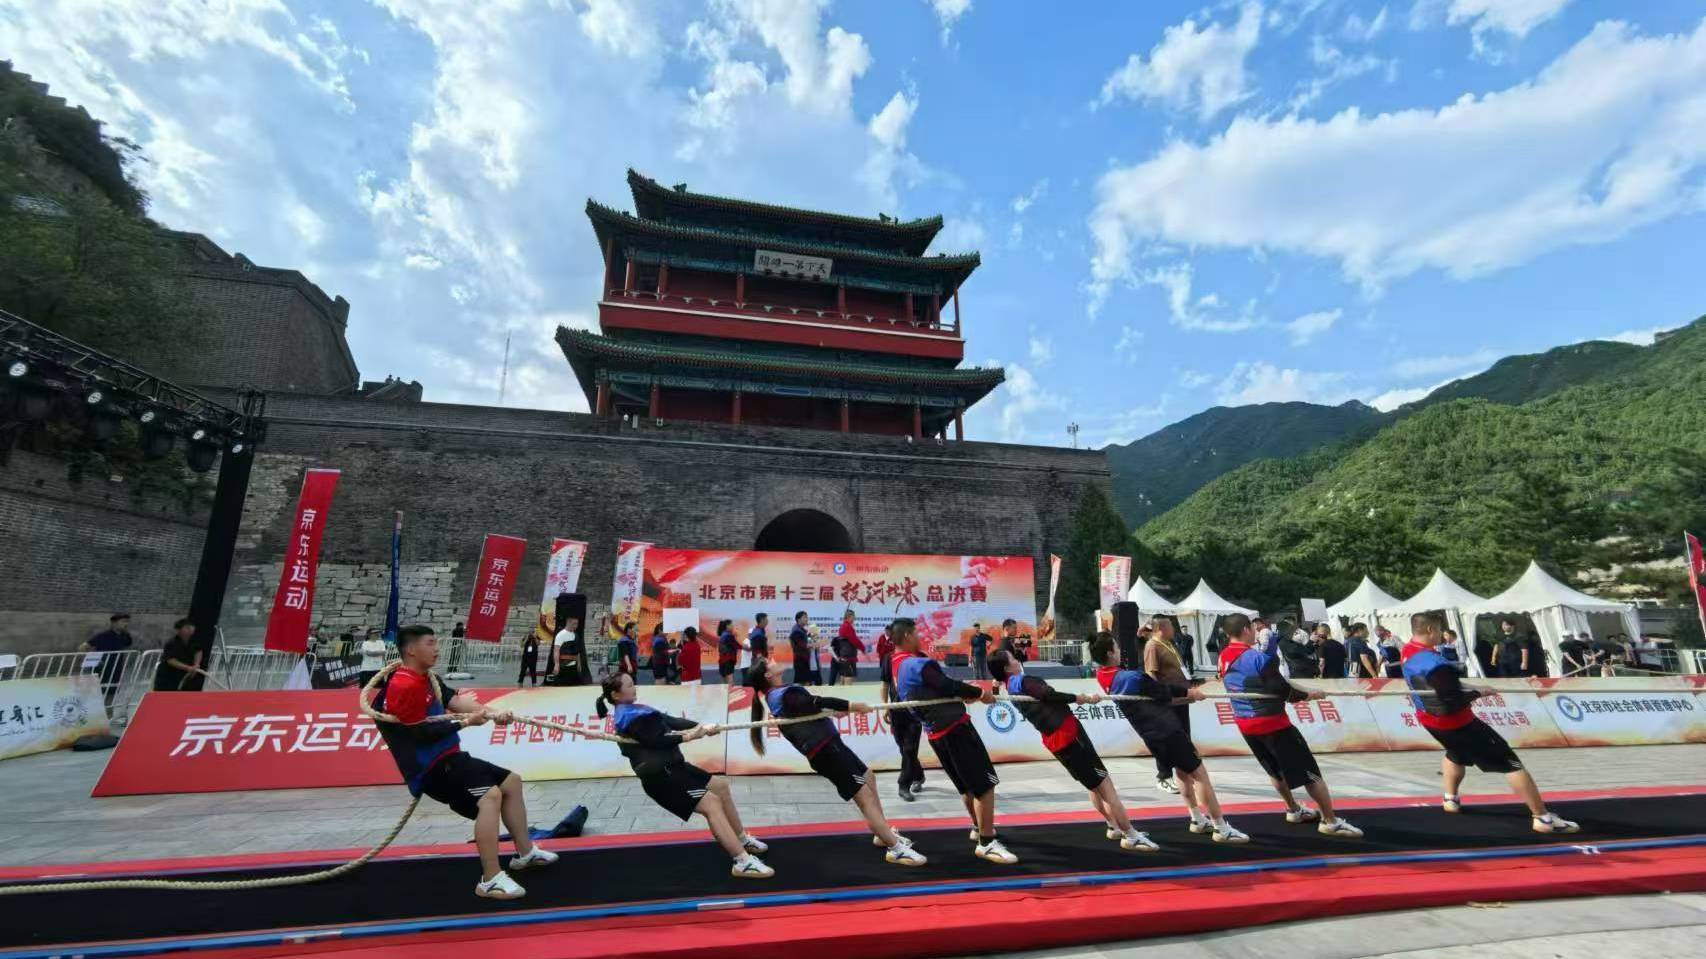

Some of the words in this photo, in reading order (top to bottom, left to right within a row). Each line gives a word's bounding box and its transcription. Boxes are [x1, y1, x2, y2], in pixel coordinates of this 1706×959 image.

[284, 508, 317, 610] 京东运动
[479, 558, 510, 617] 京东运动
[1580, 698, 1694, 713] 北京市社会体育管理中心
[169, 713, 391, 757] 京东运动
